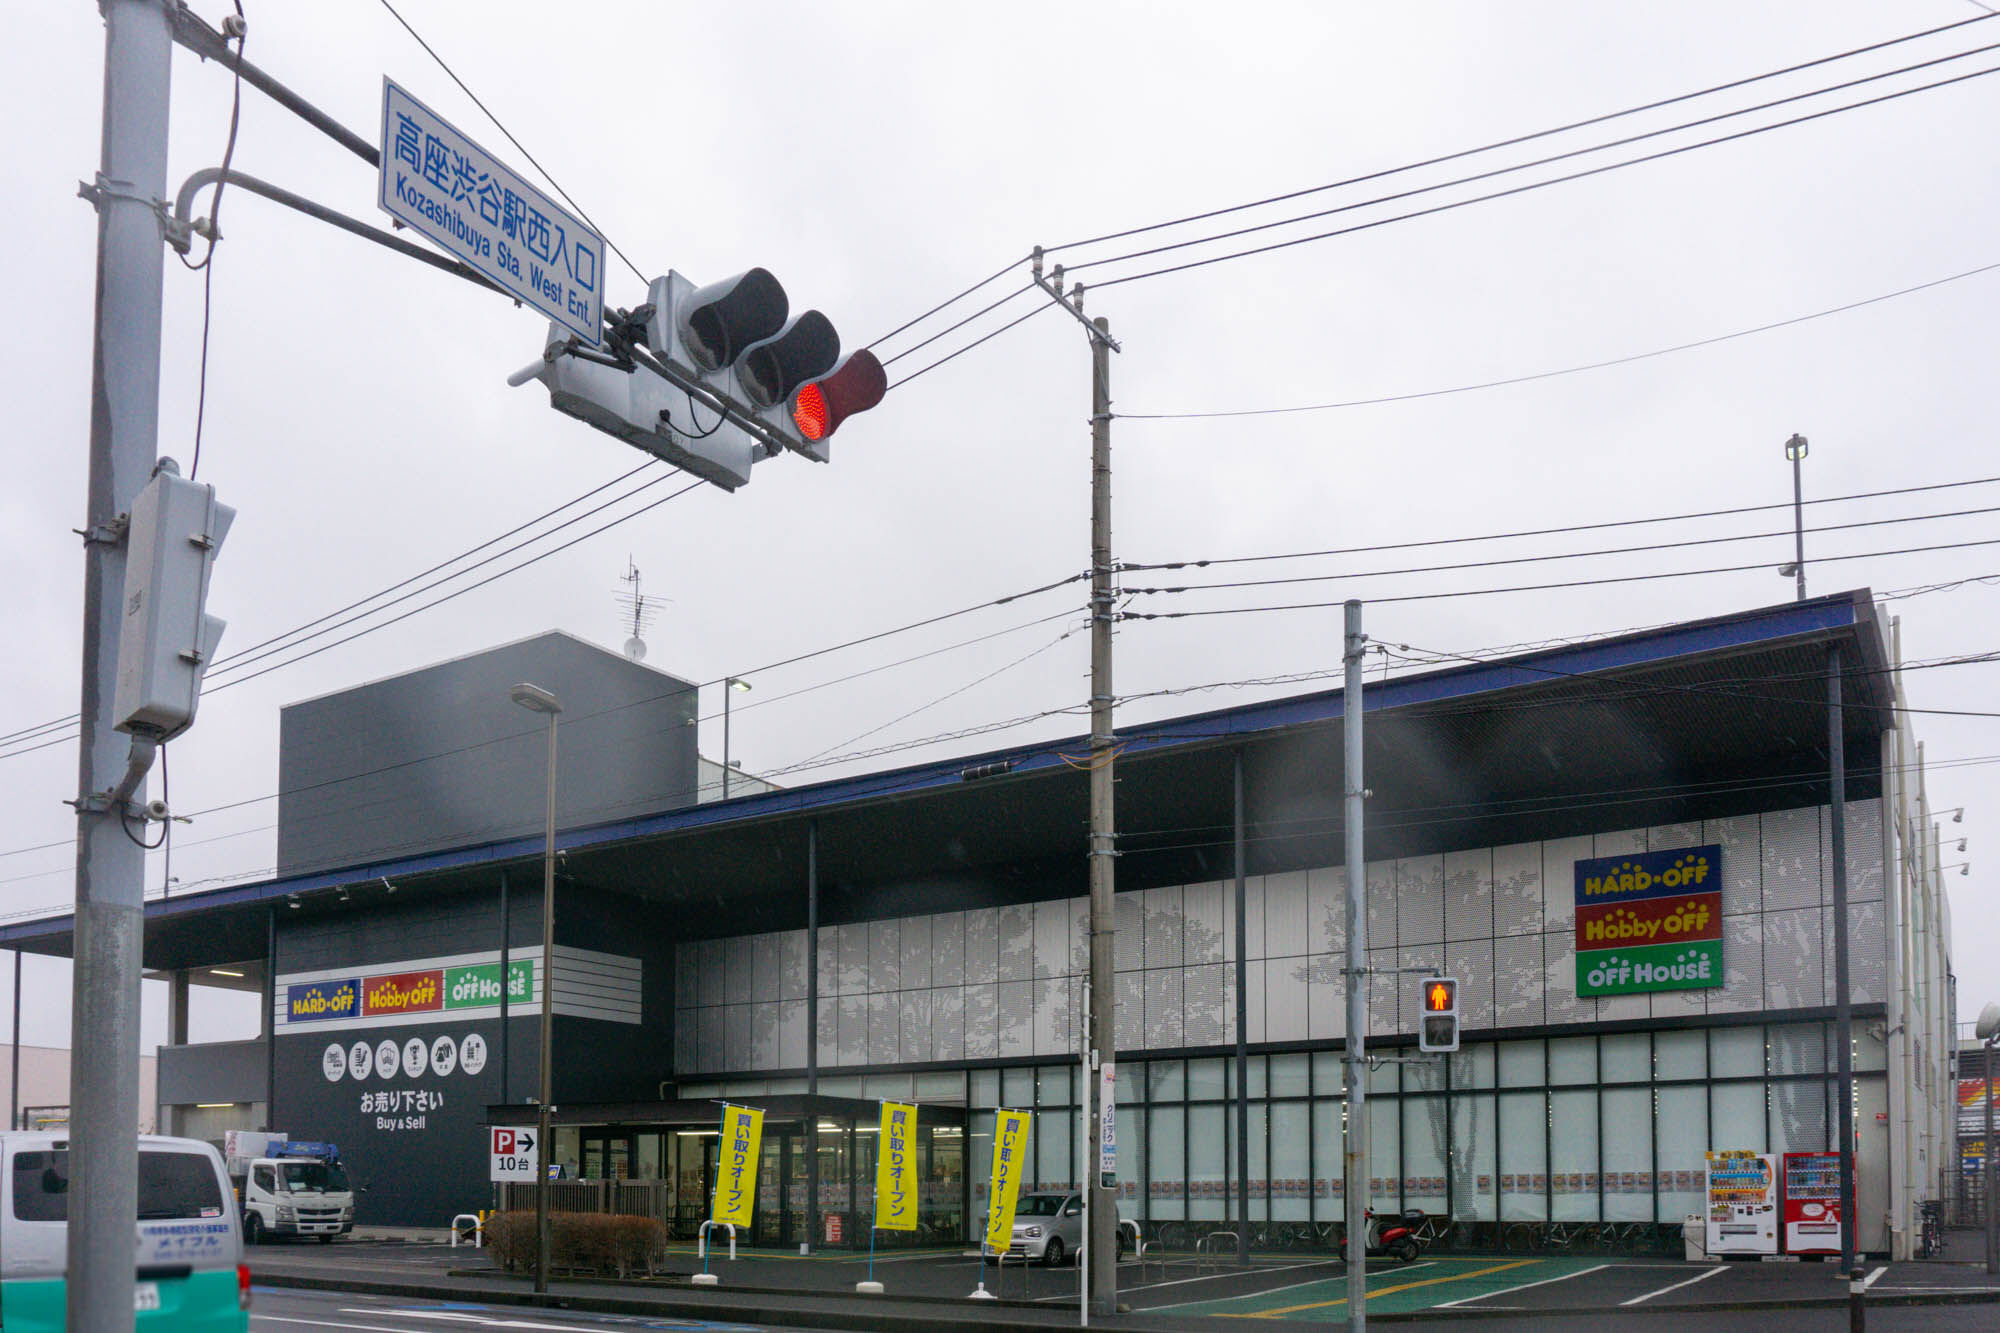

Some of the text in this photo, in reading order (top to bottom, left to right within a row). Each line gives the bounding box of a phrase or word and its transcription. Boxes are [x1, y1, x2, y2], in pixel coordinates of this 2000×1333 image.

[395, 111, 595, 292] 高座渋谷駅西入口
[396, 171, 592, 327] Kozashibuya Sta. West Ent.
[1585, 906, 1710, 942] Hobby OFF
[1587, 961, 1631, 988] OFF
[369, 981, 436, 1009] Hobby OFF
[452, 977, 479, 1001] OFF
[360, 1089, 444, 1113] お売り下さい
[376, 1115, 426, 1132] Buy & Sell
[498, 1132, 512, 1152] P
[498, 1157, 529, 1171] 10台
[728, 1113, 752, 1213] 買い取りオープン
[890, 1110, 907, 1216] 買い取りオープン
[994, 1118, 1020, 1233] 買い取りオープン
